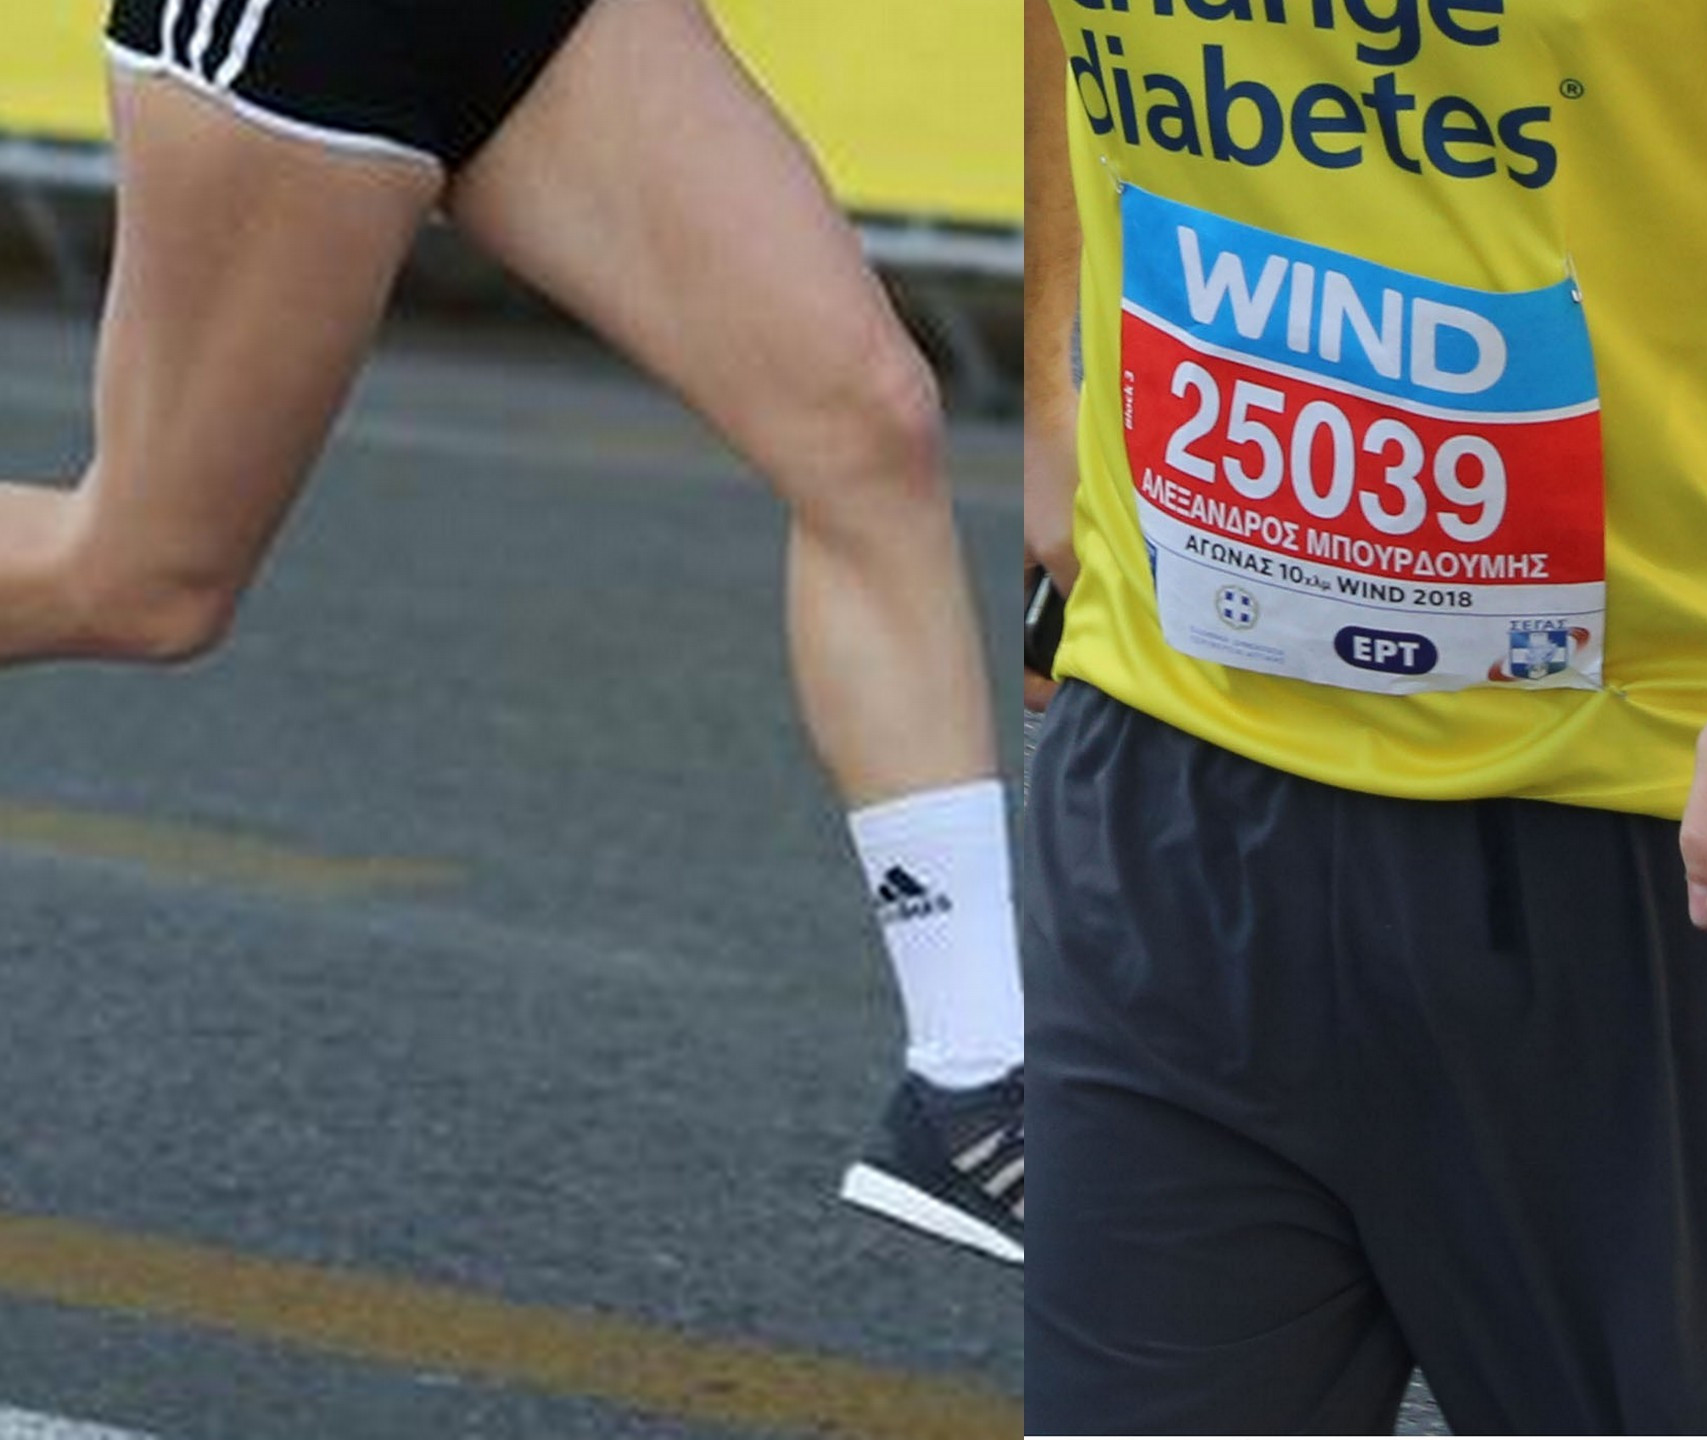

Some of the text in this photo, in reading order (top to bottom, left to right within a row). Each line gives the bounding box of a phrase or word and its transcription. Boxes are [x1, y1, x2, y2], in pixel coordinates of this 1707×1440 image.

[1177, 225, 1507, 394] WIND
[1164, 360, 1508, 542] 25039
[1142, 467, 1550, 579] ΑΛΕΞΑΝΔΡΟΣ ΜΠΟΥΡΔΟΥΜΗΣ
[1185, 534, 1273, 576] ΑΓΩΝΑΣ
[1337, 575, 1405, 603] WIND
[1413, 588, 1473, 608] 2018
